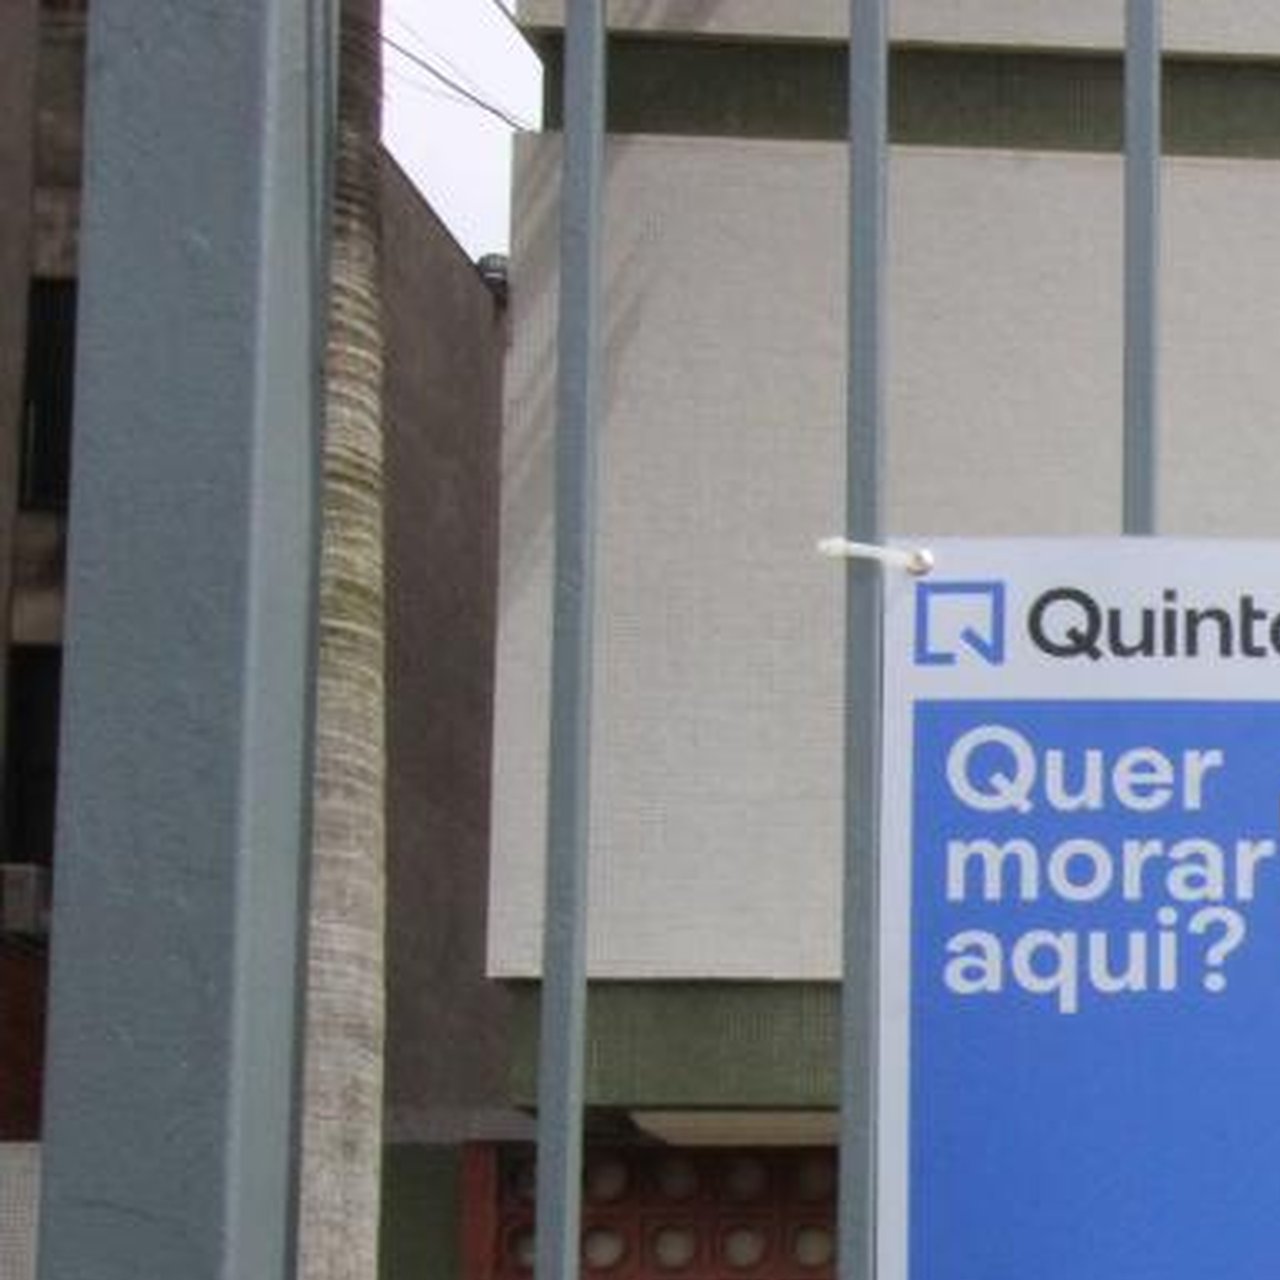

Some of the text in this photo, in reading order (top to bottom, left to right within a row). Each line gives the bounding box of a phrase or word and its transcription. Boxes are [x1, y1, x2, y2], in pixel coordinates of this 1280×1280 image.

[945, 724, 1224, 814] Quer
[946, 837, 1278, 903] morar
[943, 905, 1247, 1014] aqui?
